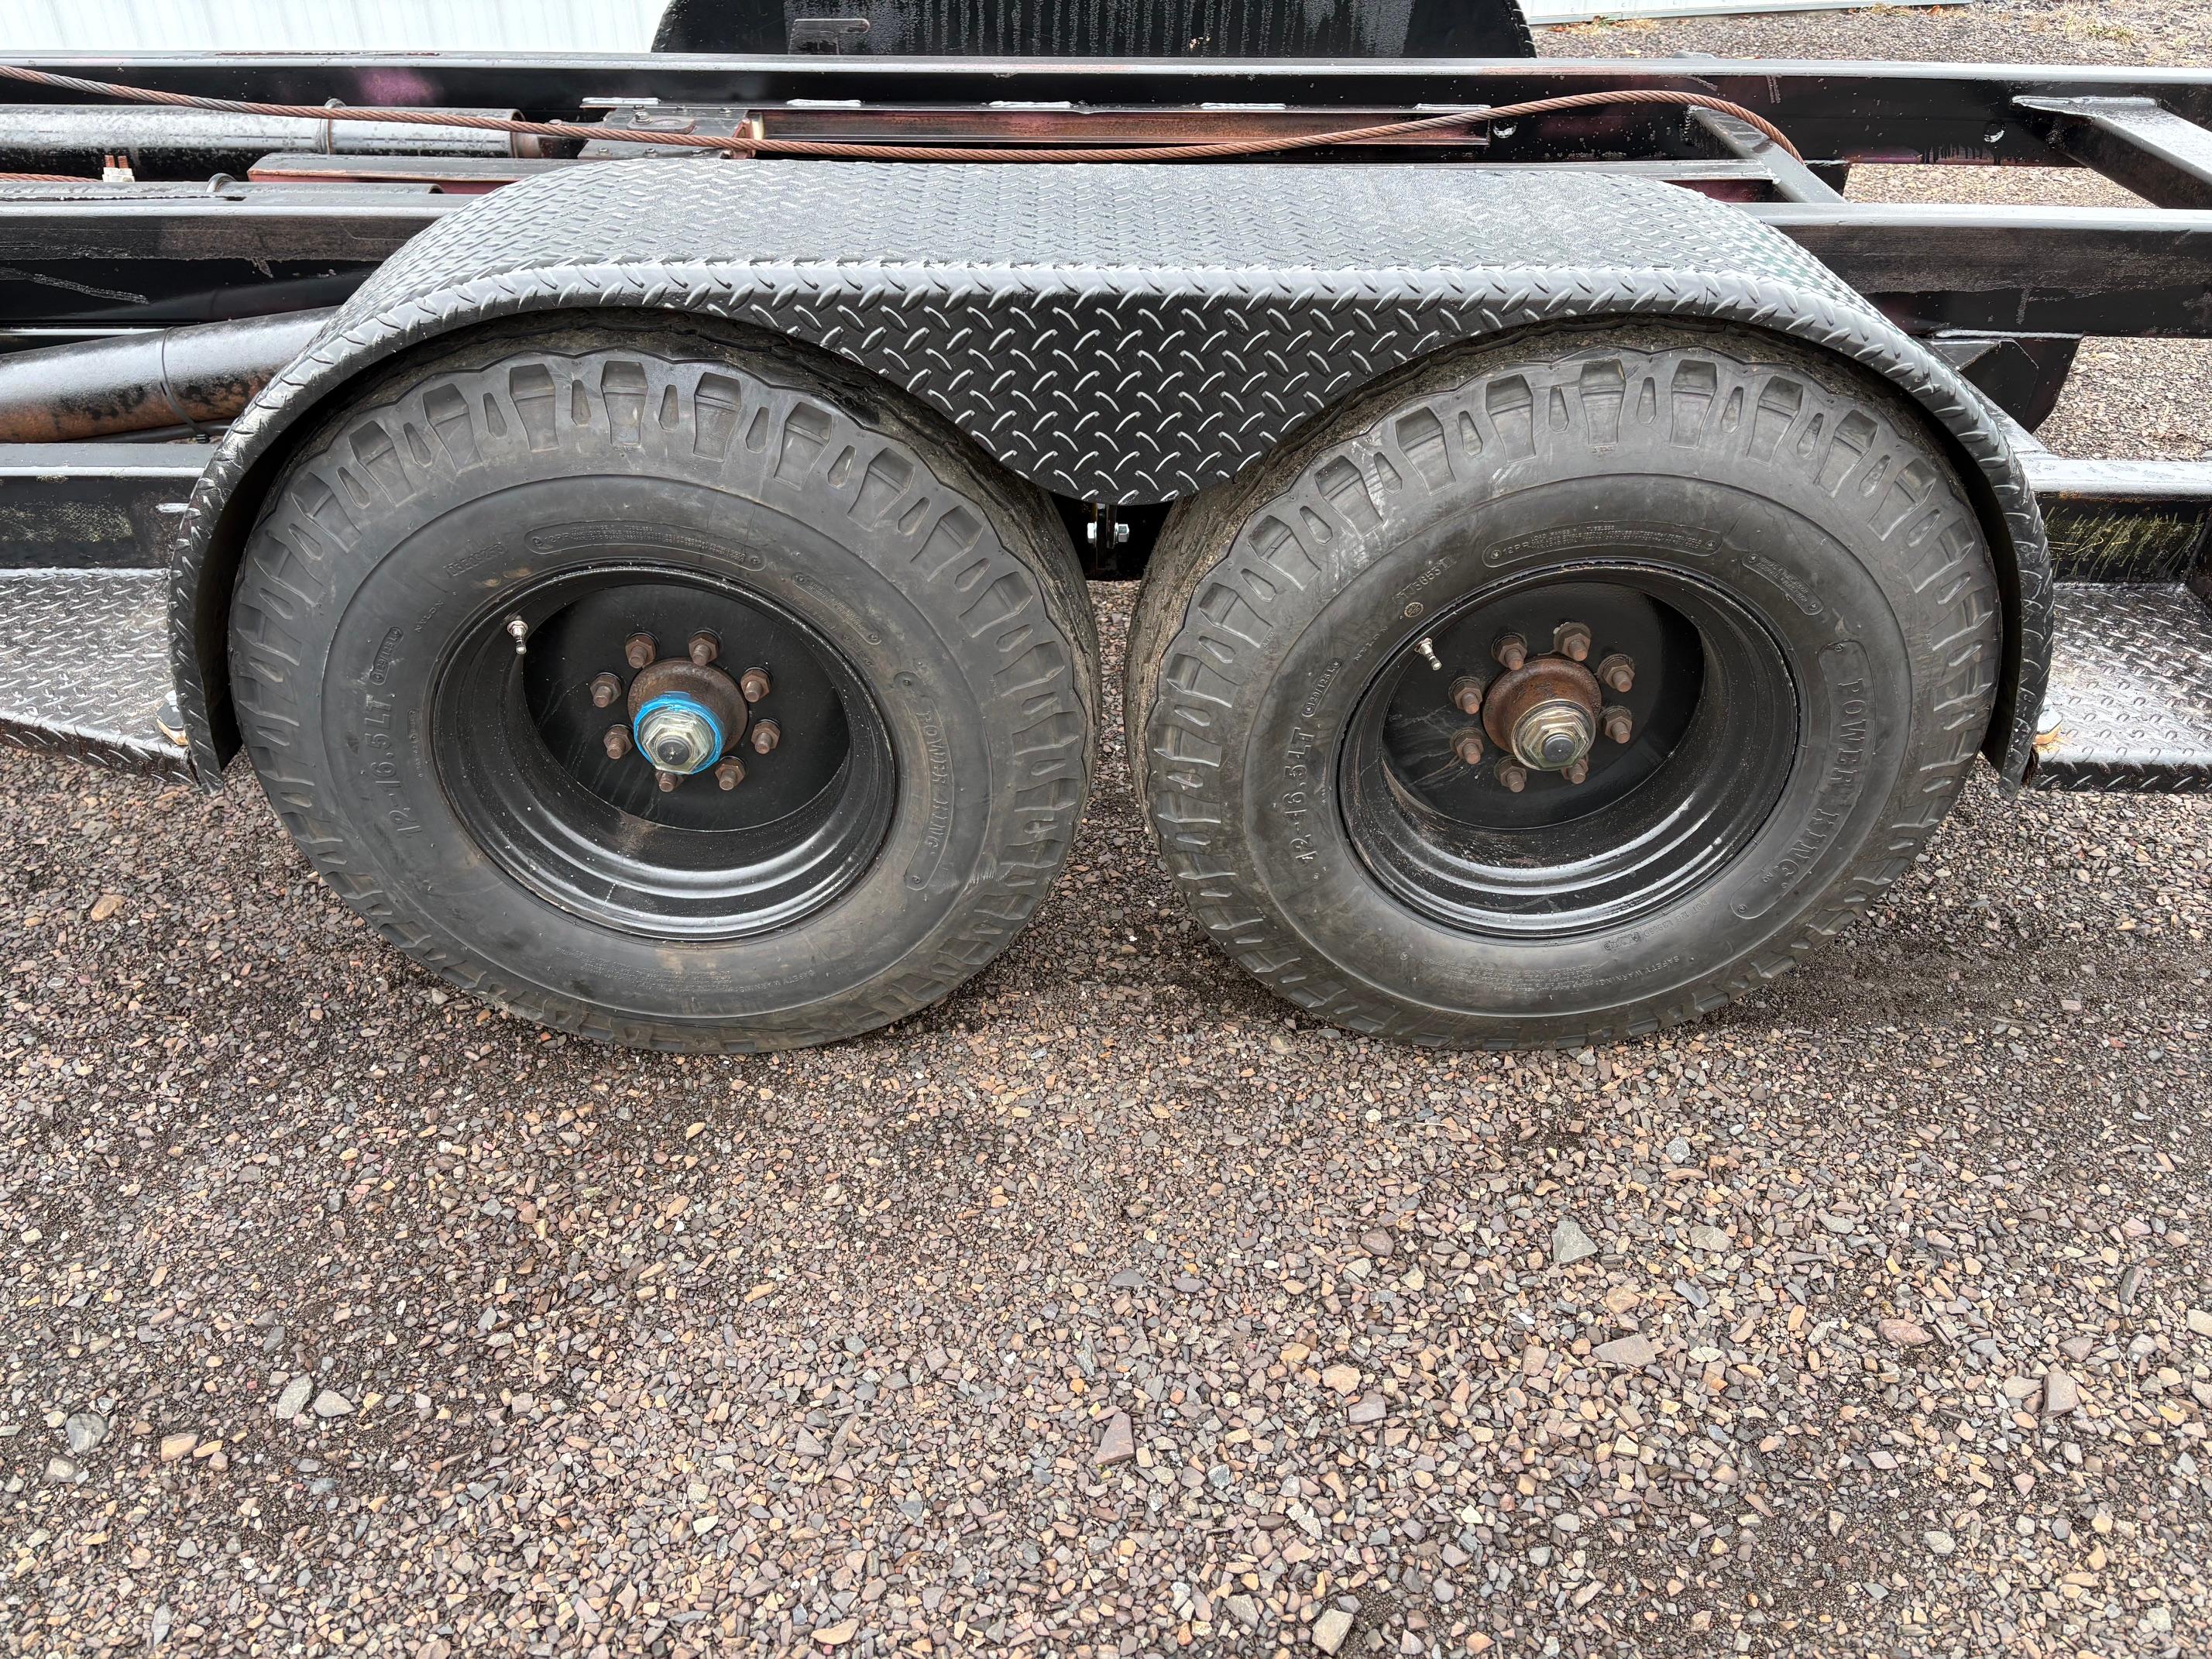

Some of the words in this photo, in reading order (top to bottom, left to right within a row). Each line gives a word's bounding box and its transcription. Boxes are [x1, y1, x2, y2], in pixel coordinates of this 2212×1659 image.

[365, 693, 423, 838] 12-16.5LT
[915, 710, 948, 785] POWER
[1830, 678, 1867, 787] POWER
[924, 799, 949, 849] KING
[1282, 726, 1317, 864] 12-16.5LT
[1777, 809, 1840, 877] KING
[1647, 955, 1680, 974] SAFETY
